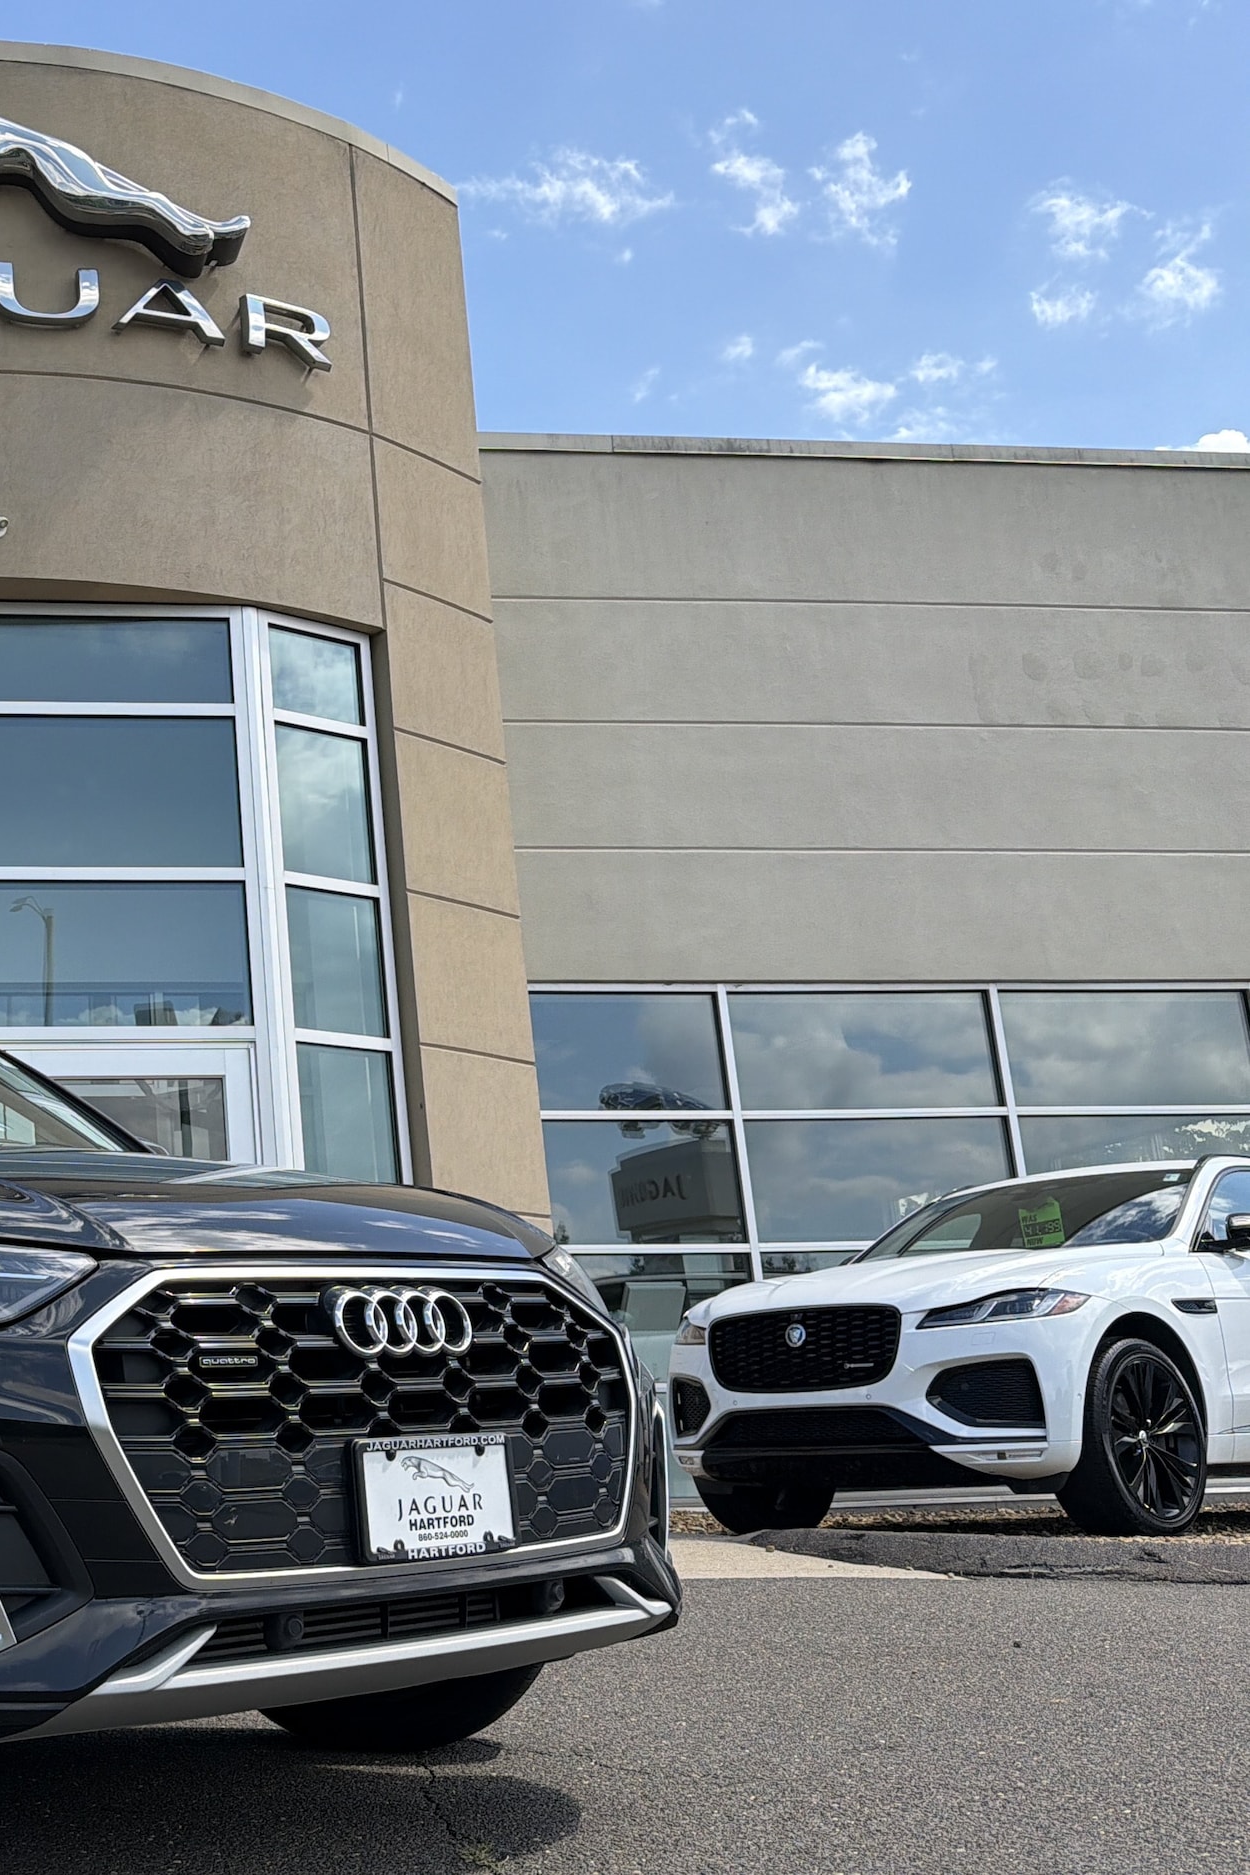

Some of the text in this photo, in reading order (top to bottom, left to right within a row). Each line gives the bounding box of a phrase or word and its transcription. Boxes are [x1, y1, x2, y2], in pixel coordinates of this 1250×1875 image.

[1022, 1214, 1037, 1223] WAS
[202, 1357, 256, 1366] quattro
[367, 1435, 505, 1451] JAGUARHARTFORD.COM
[398, 1493, 483, 1521] JAGUAR
[409, 1514, 474, 1531] HARTFORD
[418, 1530, 468, 1541] 860-524-0000
[408, 1542, 486, 1560] HARTFORD
